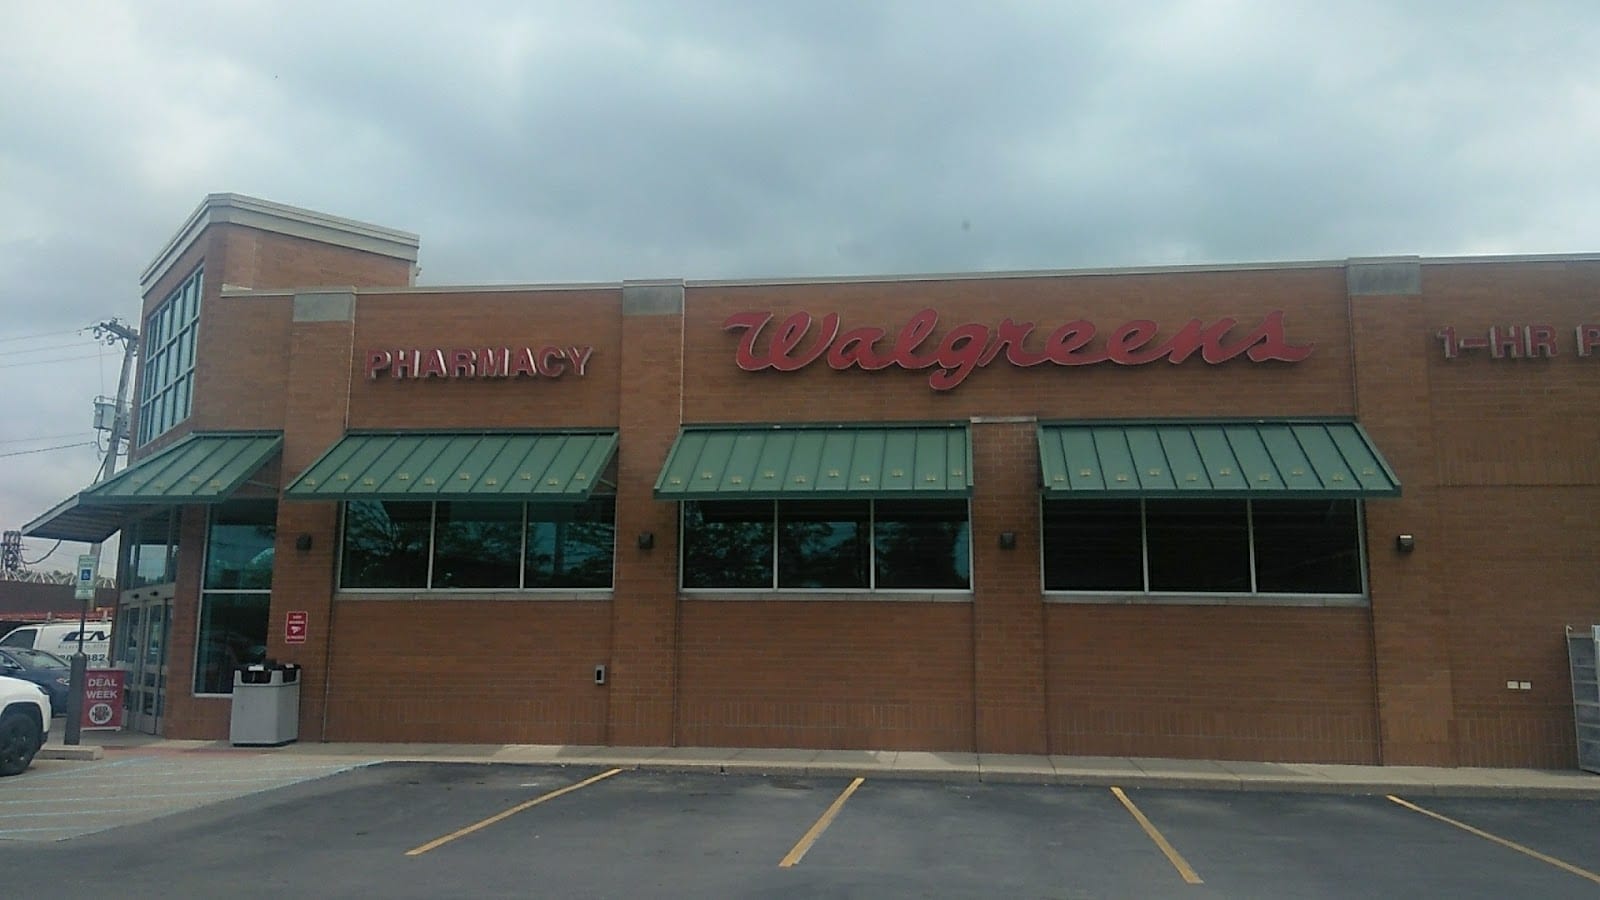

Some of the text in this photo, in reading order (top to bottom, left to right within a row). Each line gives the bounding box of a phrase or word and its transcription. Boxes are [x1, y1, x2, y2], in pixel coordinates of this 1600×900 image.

[723, 308, 1314, 391] Walgreens
[1437, 325, 1557, 358] 1-HR
[364, 346, 593, 379] PHARMACY
[86, 690, 118, 699] WEEK
[88, 678, 118, 687] DEAL
